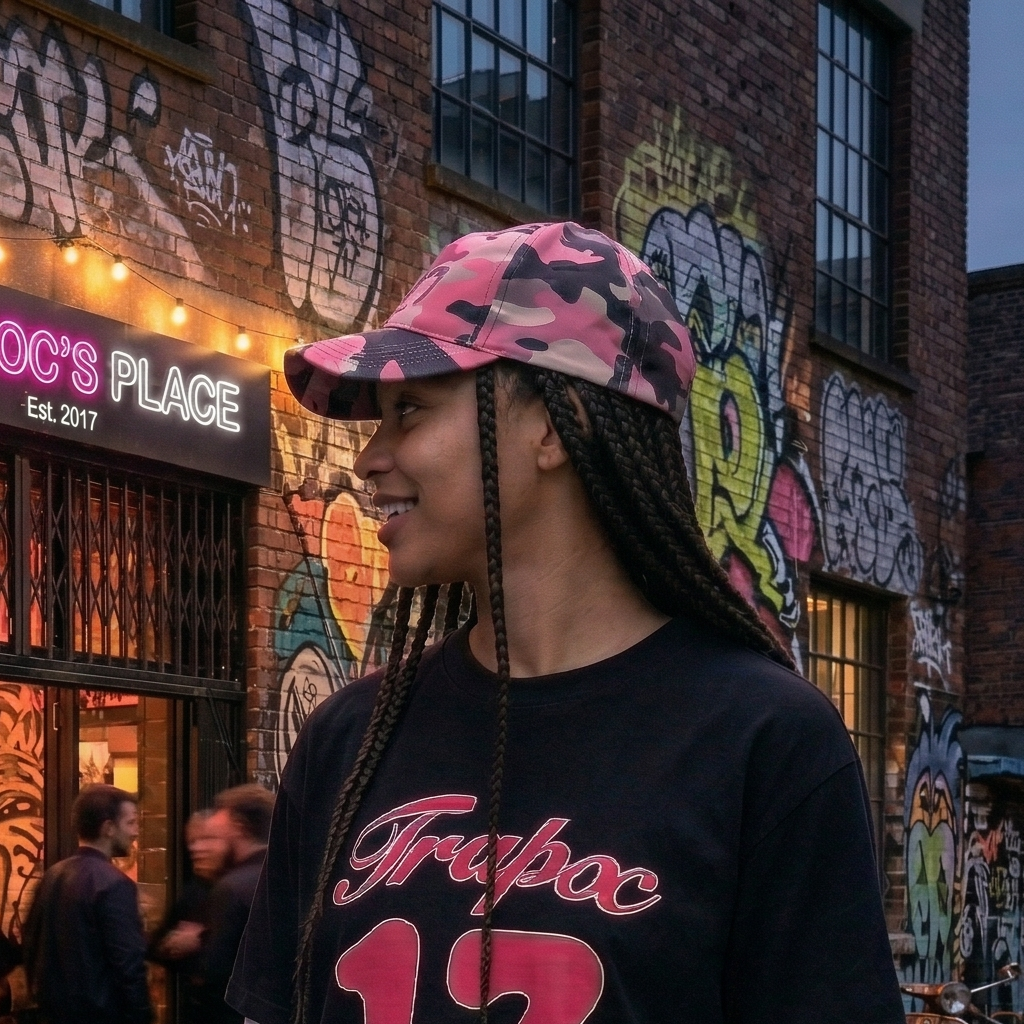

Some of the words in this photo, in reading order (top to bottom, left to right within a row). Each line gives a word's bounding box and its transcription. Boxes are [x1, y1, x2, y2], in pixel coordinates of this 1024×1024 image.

[26, 396, 57, 424] Est.
[60, 403, 99, 432] 2017
[110, 350, 242, 433] PLACE
[332, 793, 663, 917] Trapoc
